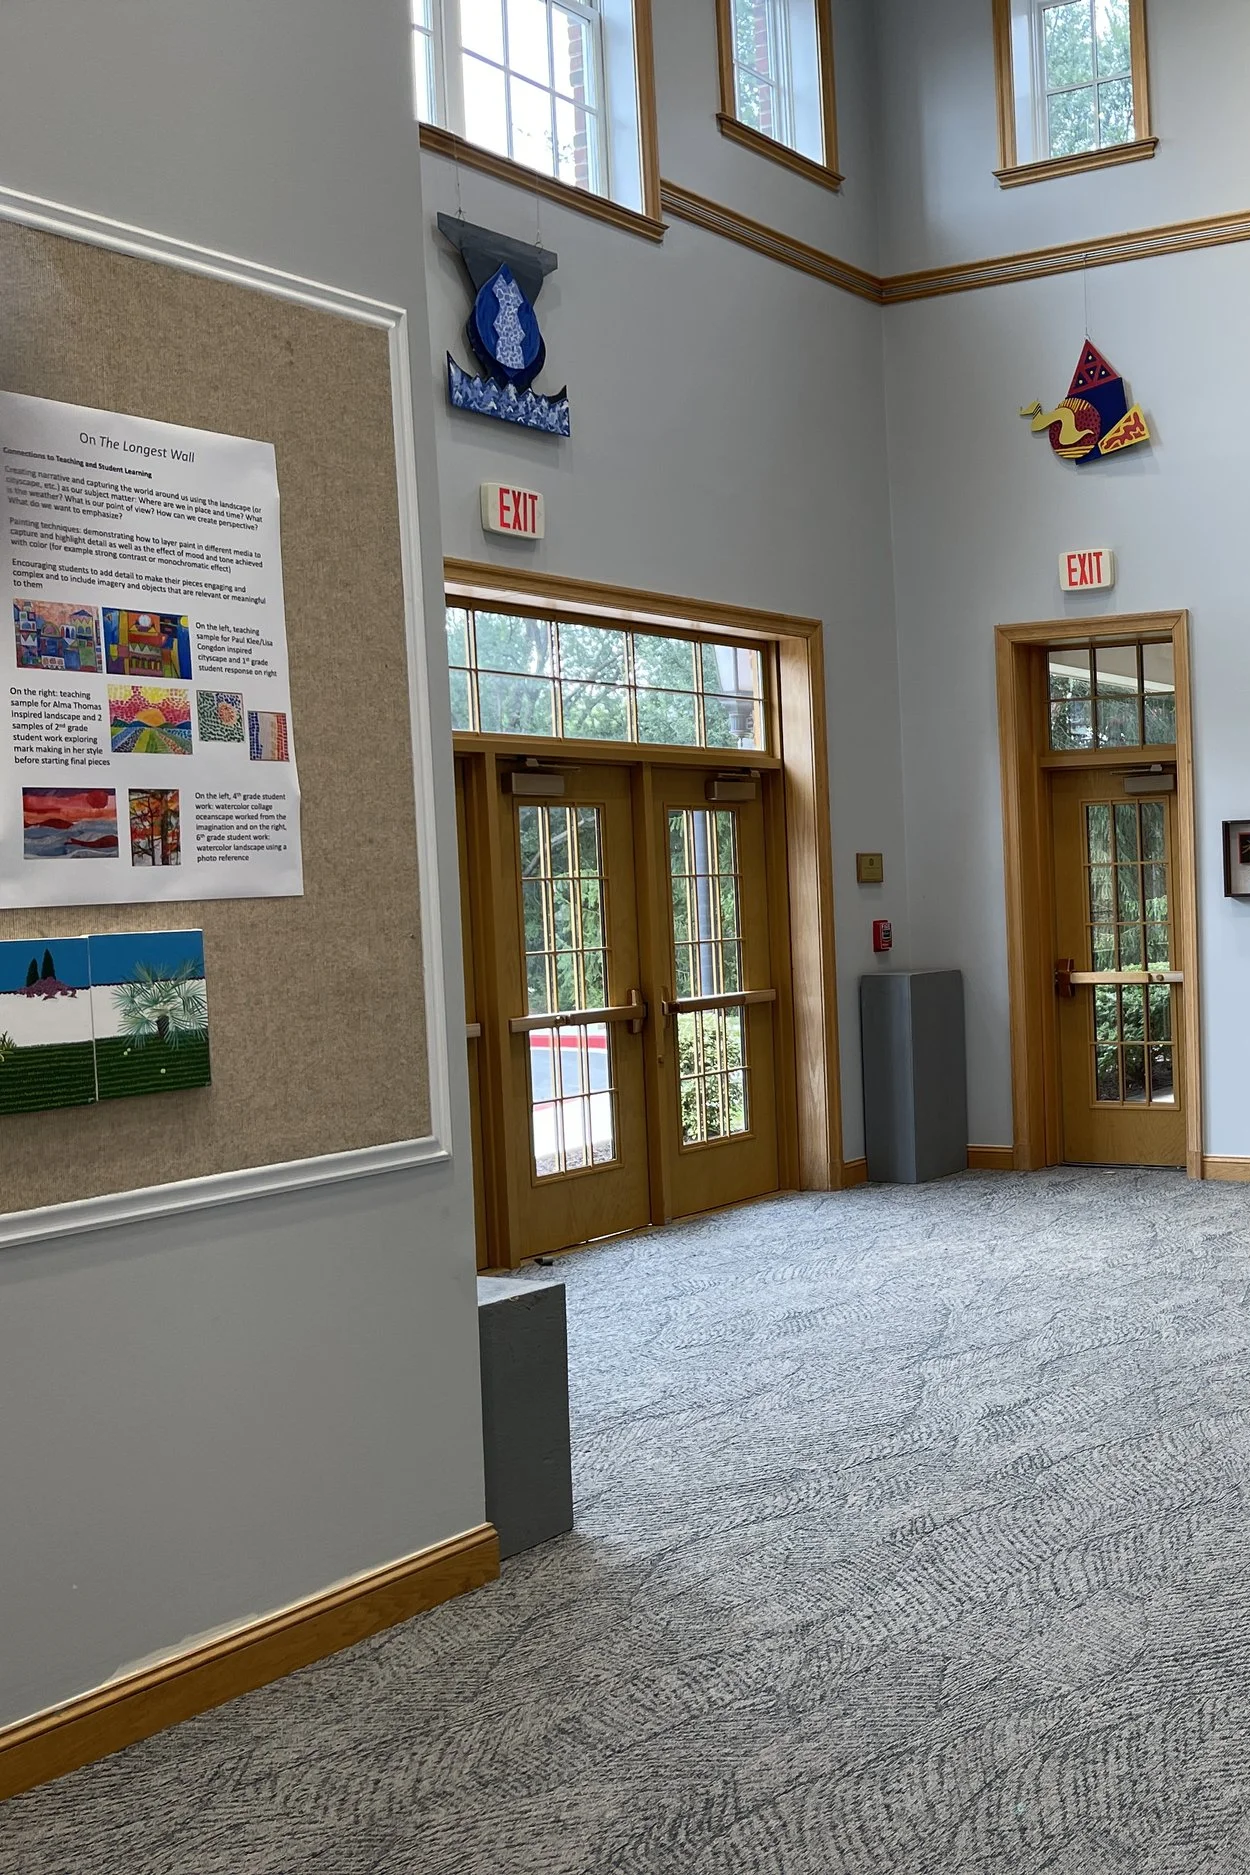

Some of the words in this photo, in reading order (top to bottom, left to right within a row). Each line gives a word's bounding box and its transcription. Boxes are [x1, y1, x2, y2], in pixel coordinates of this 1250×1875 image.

[80, 431, 96, 445] On
[99, 435, 120, 450] The
[123, 439, 167, 459] Longest
[171, 448, 194, 462] Wall
[56, 455, 84, 468] Teaching
[98, 463, 124, 473] Student
[124, 467, 152, 480] Learning
[498, 487, 538, 534] EXIT
[1066, 551, 1103, 587] EXIT
[12, 558, 57, 573] Encouraging
[58, 564, 89, 574] students
[100, 569, 113, 577] add
[114, 570, 134, 580] detail
[144, 575, 163, 583] make
[164, 576, 181, 585] their
[182, 579, 203, 588] pieces
[204, 583, 233, 594] engaging
[12, 570, 44, 580] complex
[70, 575, 96, 585] include
[97, 578, 126, 590] imagery
[142, 583, 166, 594] objects
[167, 586, 182, 595] that
[195, 590, 222, 600] relevant
[231, 596, 266, 606] meaningful
[23, 580, 43, 589] them
[196, 622, 206, 630] On
[232, 626, 260, 637] teaching
[196, 633, 220, 643] sample
[221, 635, 230, 643] for
[232, 636, 245, 644] Paul
[197, 644, 226, 653] Congdon
[227, 646, 252, 655] inspired
[198, 654, 227, 664] cityscape
[251, 659, 268, 667] grade
[198, 665, 223, 673] student
[224, 667, 253, 676] response
[264, 670, 277, 678] right
[60, 691, 91, 701] teaching
[11, 700, 39, 709] sample
[73, 702, 102, 710] Thomas
[44, 712, 80, 722] landscape
[12, 723, 44, 732] samples
[67, 725, 88, 733] grade
[64, 736, 98, 745] exploring
[36, 746, 63, 755] making
[86, 747, 103, 756] style
[41, 758, 70, 766] starting
[88, 759, 110, 767] pieces
[243, 793, 261, 802] grade
[251, 803, 273, 812] collage
[196, 824, 235, 832] imagination
[206, 834, 225, 843] grade
[233, 844, 265, 852] landscape
[266, 844, 282, 852] using
[197, 854, 217, 863] photo
